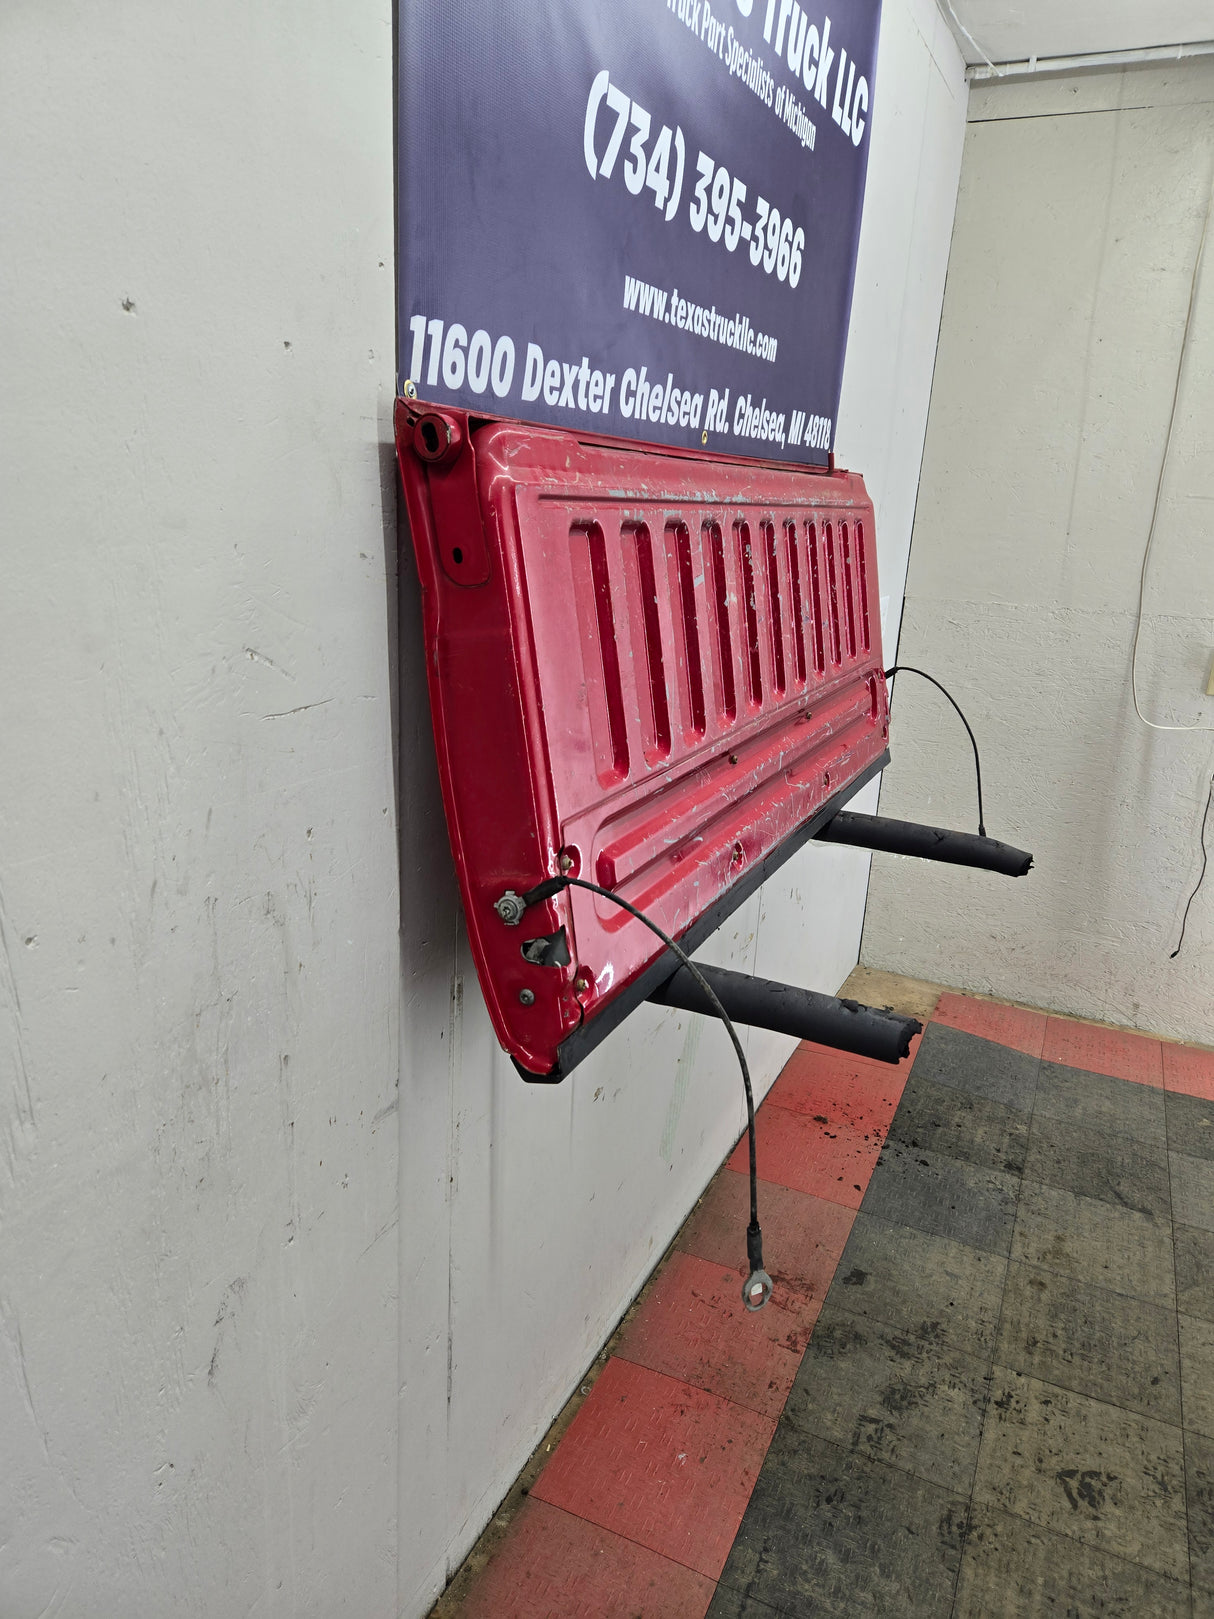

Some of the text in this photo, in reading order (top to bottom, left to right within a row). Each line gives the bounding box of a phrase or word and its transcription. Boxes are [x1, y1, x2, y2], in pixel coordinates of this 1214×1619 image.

[666, 0, 816, 152] uck Part Specialists of Michigan
[832, 48, 869, 147] LLC
[584, 70, 804, 288] (734) 395-3966
[410, 315, 832, 450] 11600 Dexter Chelsea Rd. Chelsea, MI 48118
[623, 275, 778, 362] www.texastruckllc.com
